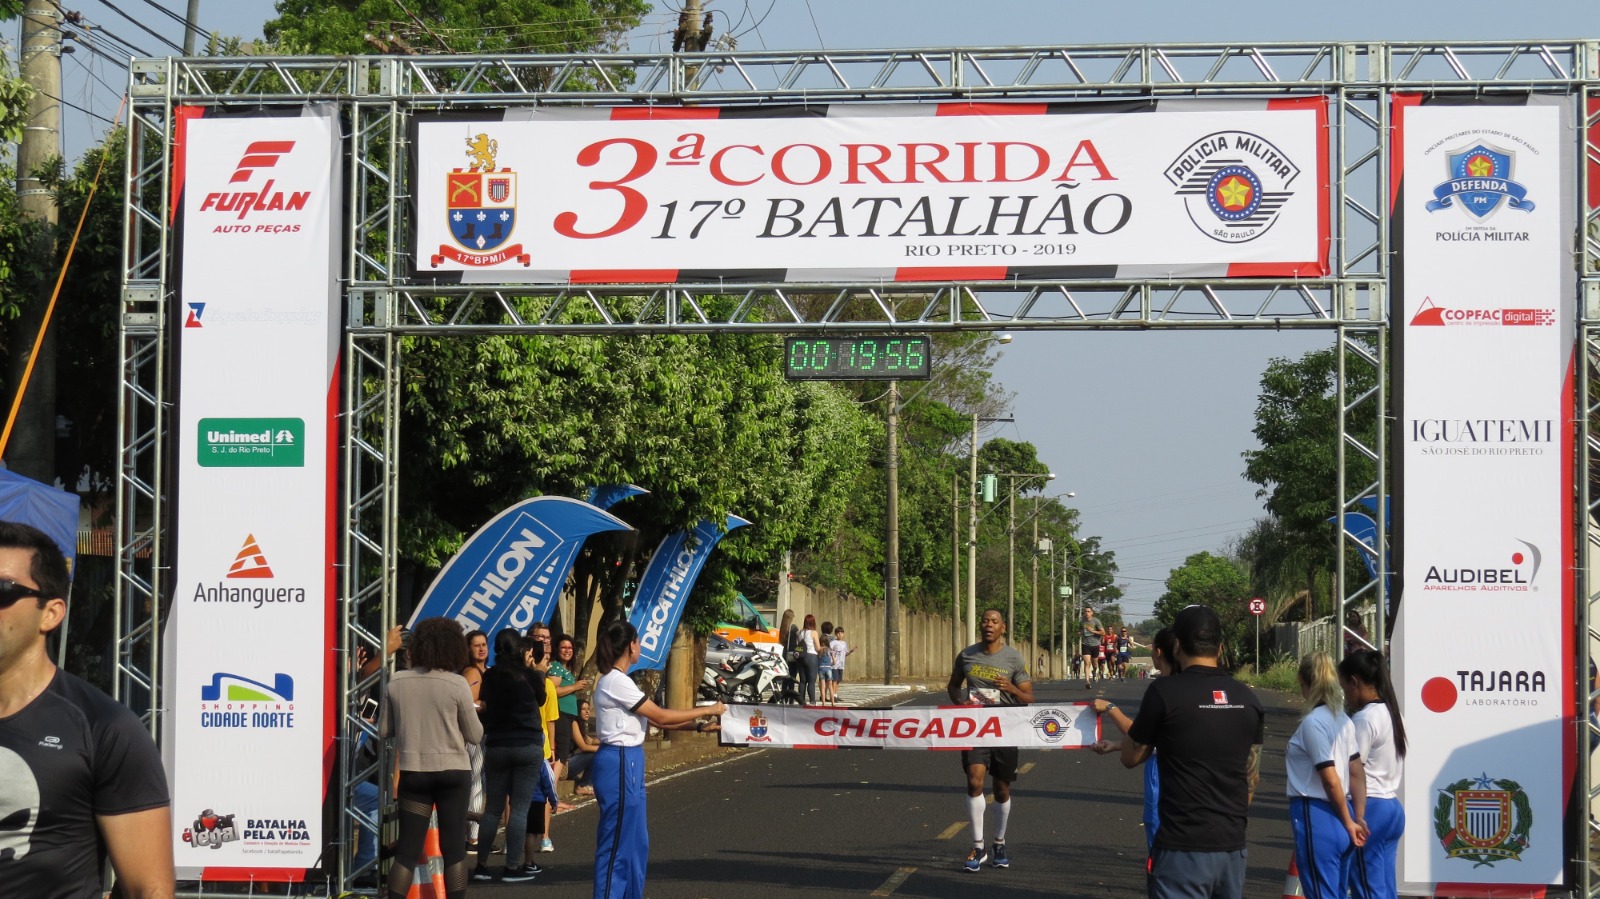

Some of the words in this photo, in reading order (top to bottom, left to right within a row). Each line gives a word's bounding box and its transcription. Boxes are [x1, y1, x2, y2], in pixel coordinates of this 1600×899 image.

[709, 139, 1119, 187] CORRIDA
[1172, 136, 1229, 181] POLICIA
[1235, 135, 1291, 180] MILITAR
[1451, 180, 1508, 192] DEFENDA
[199, 179, 311, 220] FURLAN
[651, 198, 746, 240] 17º
[755, 182, 1133, 238] BATALHÃO
[212, 225, 252, 233] AUTO
[255, 224, 301, 234] PEÇAS
[1213, 229, 1228, 239] SÃO
[1230, 228, 1256, 239] PAULO
[1435, 229, 1481, 241] POLÍCIA
[1484, 231, 1530, 241] MILITAR
[905, 245, 941, 257] RIO
[948, 244, 1017, 256] PRETO
[1033, 243, 1077, 256] 2019
[1445, 309, 1500, 320] COPFAC
[1504, 311, 1534, 324] digital
[207, 430, 270, 443] Unimed
[1410, 418, 1555, 443] IGUATEMI
[1421, 446, 1443, 456] SÃO
[1444, 446, 1470, 456] JOSÉ
[1472, 448, 1487, 456] DO
[1488, 448, 1507, 456] RIO
[1509, 448, 1543, 456] PRETO
[454, 528, 546, 637] ATHLON
[1424, 565, 1527, 584] AUDIBEL
[193, 581, 305, 609] Anhanguera
[1480, 584, 1528, 592] AUDITIVOS
[1456, 670, 1546, 692] TAJARA
[1465, 698, 1538, 706] LABORATÓRIO
[201, 711, 248, 728] CIDADE
[252, 712, 294, 728] NORTE
[813, 716, 1003, 739] CHEGADA
[247, 819, 307, 829] BATALHA
[190, 820, 241, 850] legal
[243, 830, 275, 840] PELA
